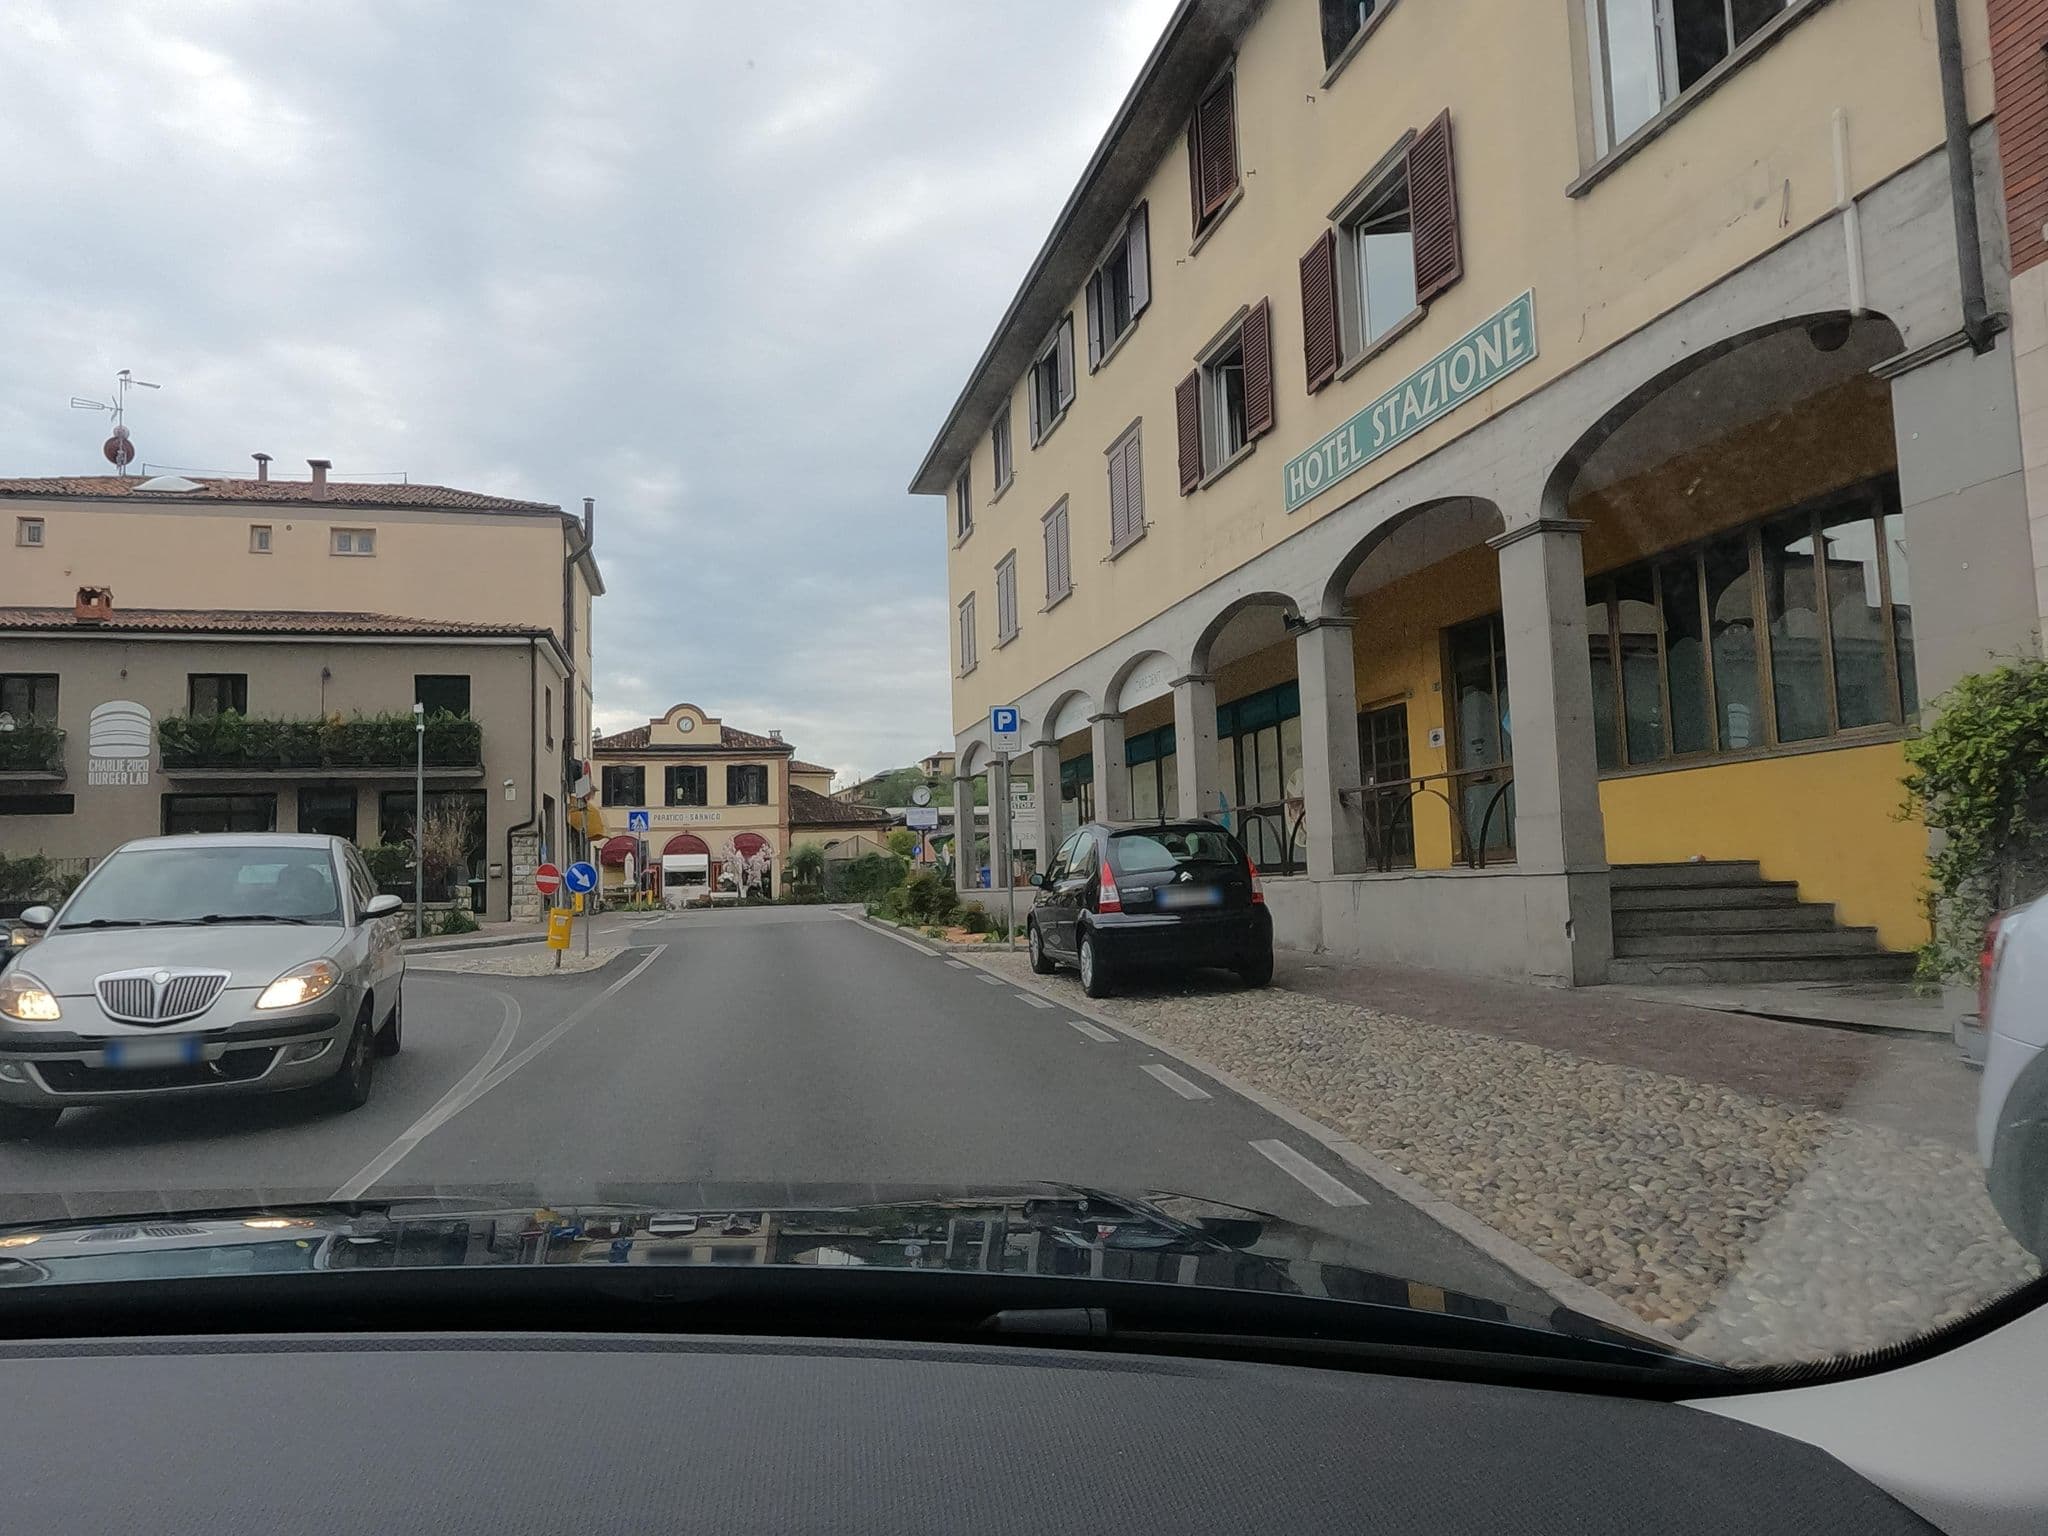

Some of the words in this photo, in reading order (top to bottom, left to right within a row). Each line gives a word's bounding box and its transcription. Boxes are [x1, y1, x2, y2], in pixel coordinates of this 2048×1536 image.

[1289, 426, 1362, 502] HOTEL
[1372, 308, 1525, 447] STAZIONE
[998, 711, 1012, 730] P
[88, 759, 125, 772] CHARLIE
[127, 759, 149, 772] 2020
[88, 772, 127, 785] BURGER
[129, 772, 149, 785] LAB
[654, 813, 684, 821] PARATICO
